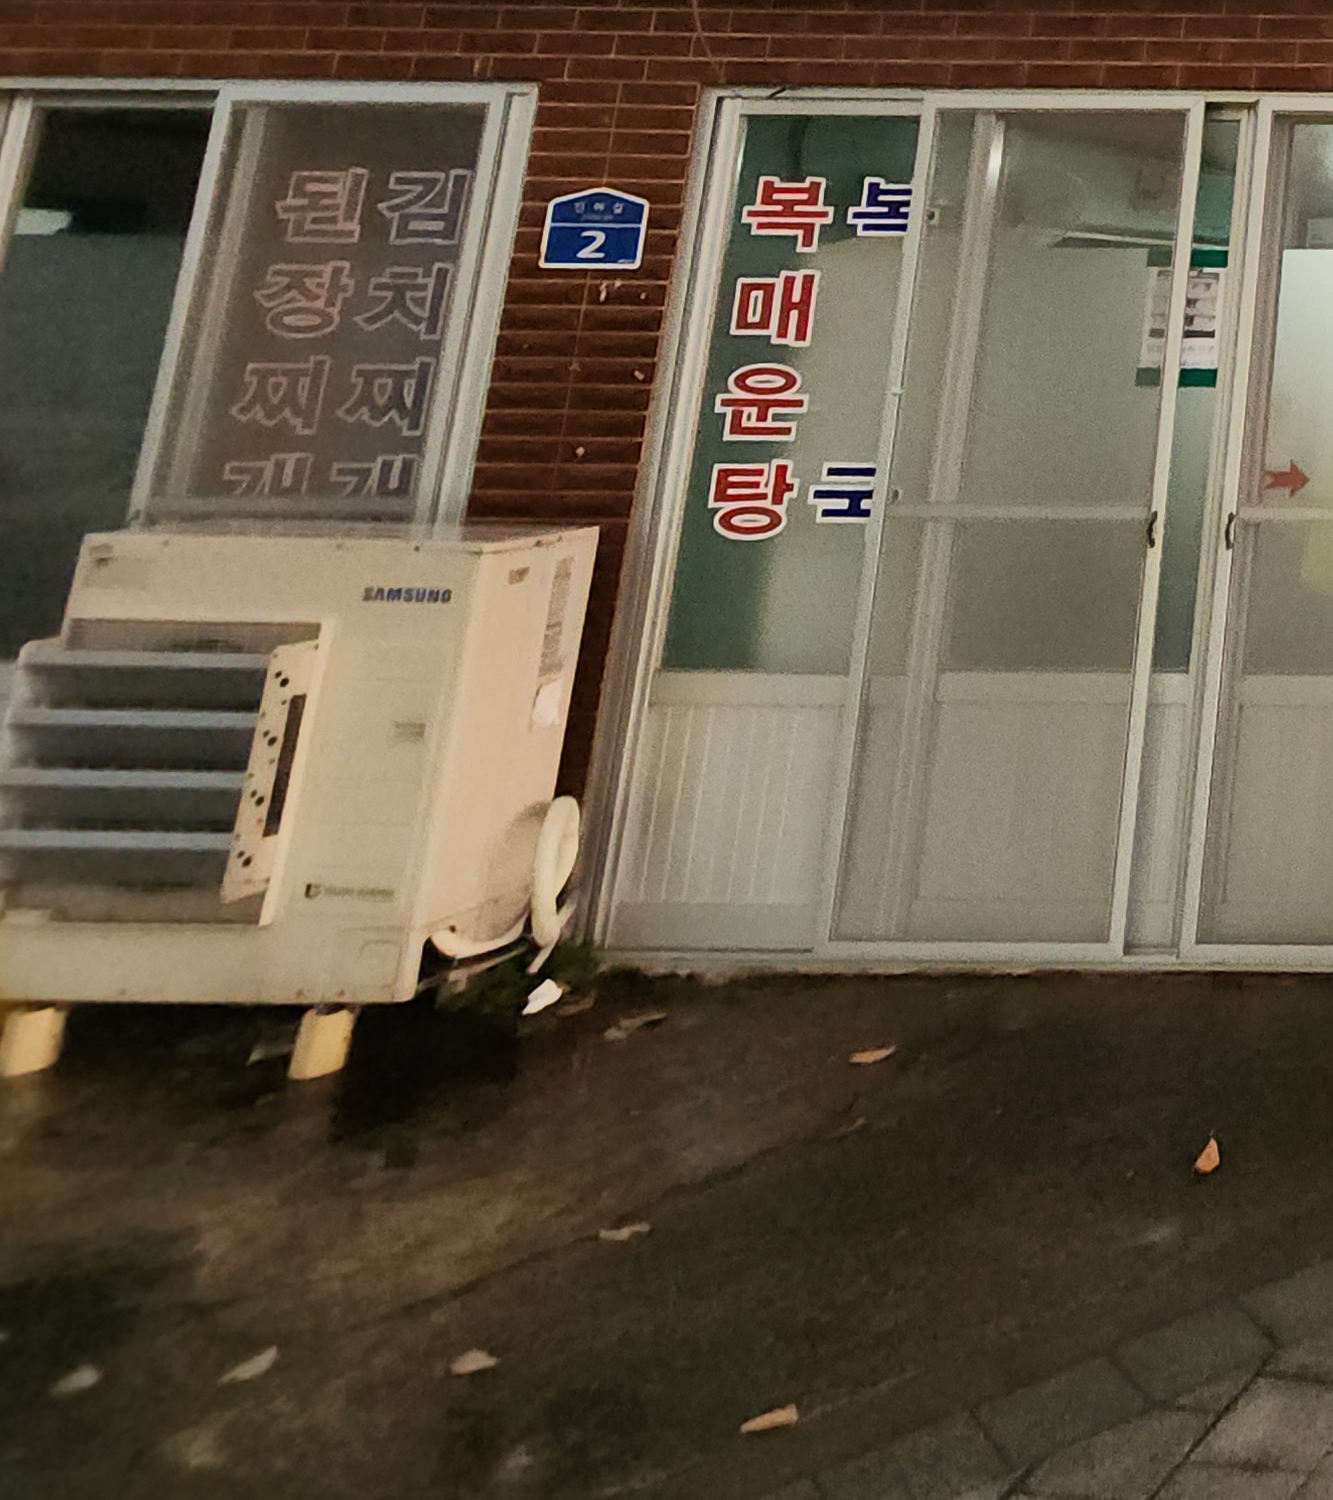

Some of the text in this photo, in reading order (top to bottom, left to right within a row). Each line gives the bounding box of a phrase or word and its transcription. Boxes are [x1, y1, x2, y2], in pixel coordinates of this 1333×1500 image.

[575, 230, 606, 258] 2
[708, 176, 834, 540] 복매운탕
[362, 586, 453, 605] SAMSUNG
